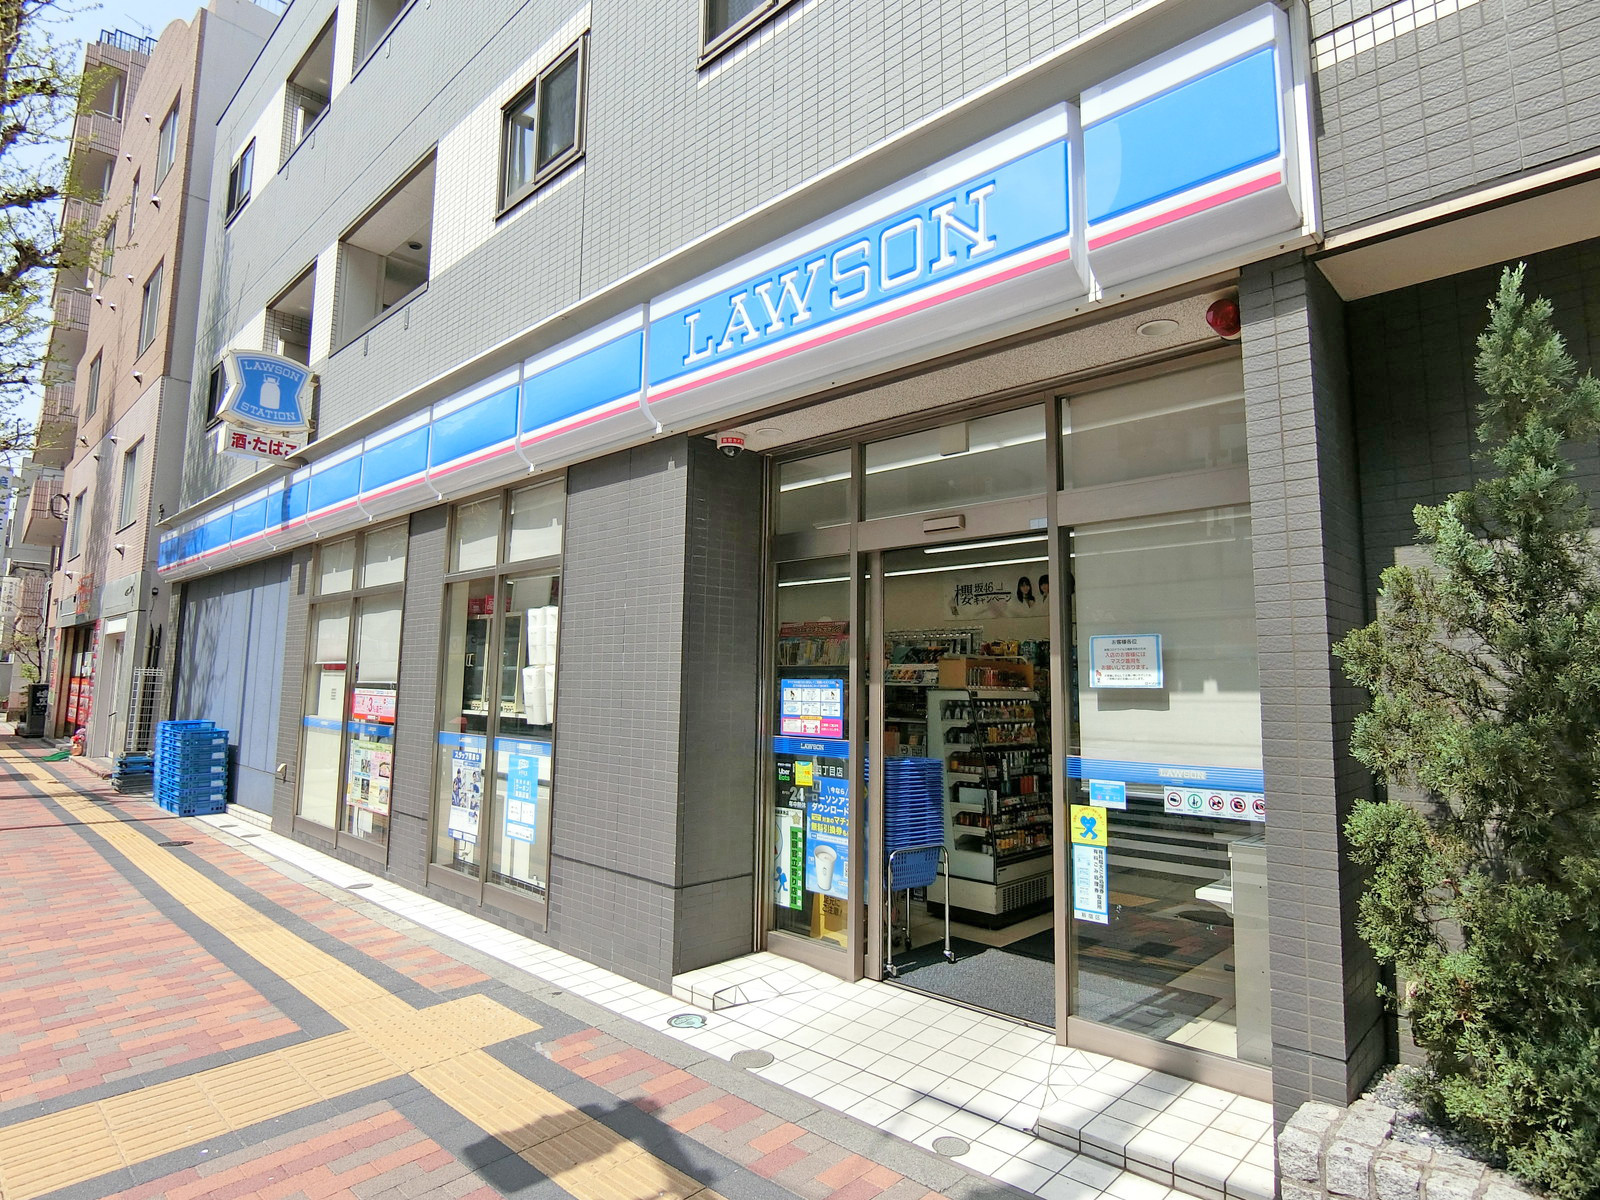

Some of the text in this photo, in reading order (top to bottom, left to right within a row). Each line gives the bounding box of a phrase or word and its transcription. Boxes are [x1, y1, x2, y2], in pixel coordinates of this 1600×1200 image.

[683, 182, 997, 366] LAWSON
[244, 361, 301, 382] LAWSON
[240, 402, 296, 421] STATION
[974, 594, 1012, 605] キャンペーン
[778, 767, 790, 775] Uber
[1158, 768, 1208, 780] LAWSON
[789, 786, 806, 802] 24
